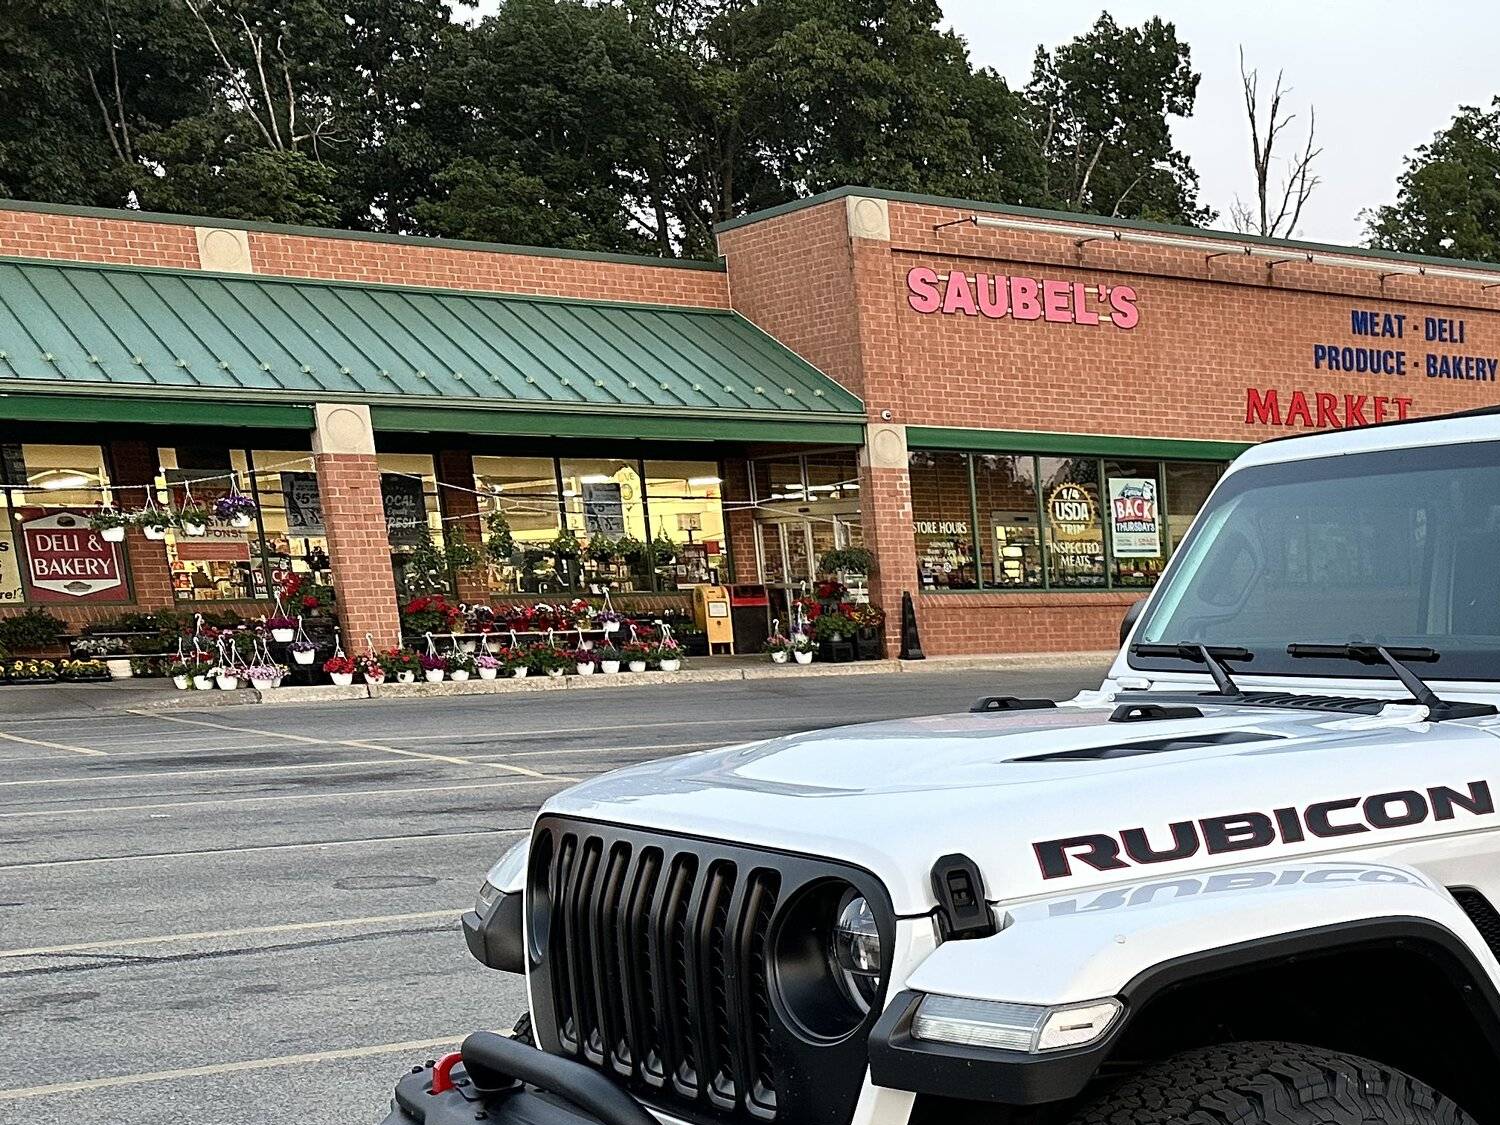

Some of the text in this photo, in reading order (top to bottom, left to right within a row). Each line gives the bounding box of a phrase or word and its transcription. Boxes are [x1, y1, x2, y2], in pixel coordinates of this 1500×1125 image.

[907, 266, 1139, 329] SAUBEL'S
[1351, 310, 1465, 344] MEAT DELI
[1313, 344, 1499, 382] PRODUCE BAKERY
[1245, 388, 1412, 428] MARKET
[385, 495, 416, 506] OCAL
[1062, 488, 1080, 500] 1/4
[1055, 502, 1090, 520] USDA
[1115, 499, 1152, 519] BACK
[386, 517, 416, 528] RESH
[913, 522, 967, 534] STORE HOURS
[1061, 524, 1086, 535] TRIM
[1117, 521, 1156, 532] THURSDAYS
[36, 534, 103, 552] DELI &
[1050, 542, 1099, 555] INSPECTED
[34, 558, 111, 576] BAKERY
[1061, 555, 1090, 567] MEATS
[254, 570, 289, 584] BCK
[1032, 779, 1495, 880] RUBICON
